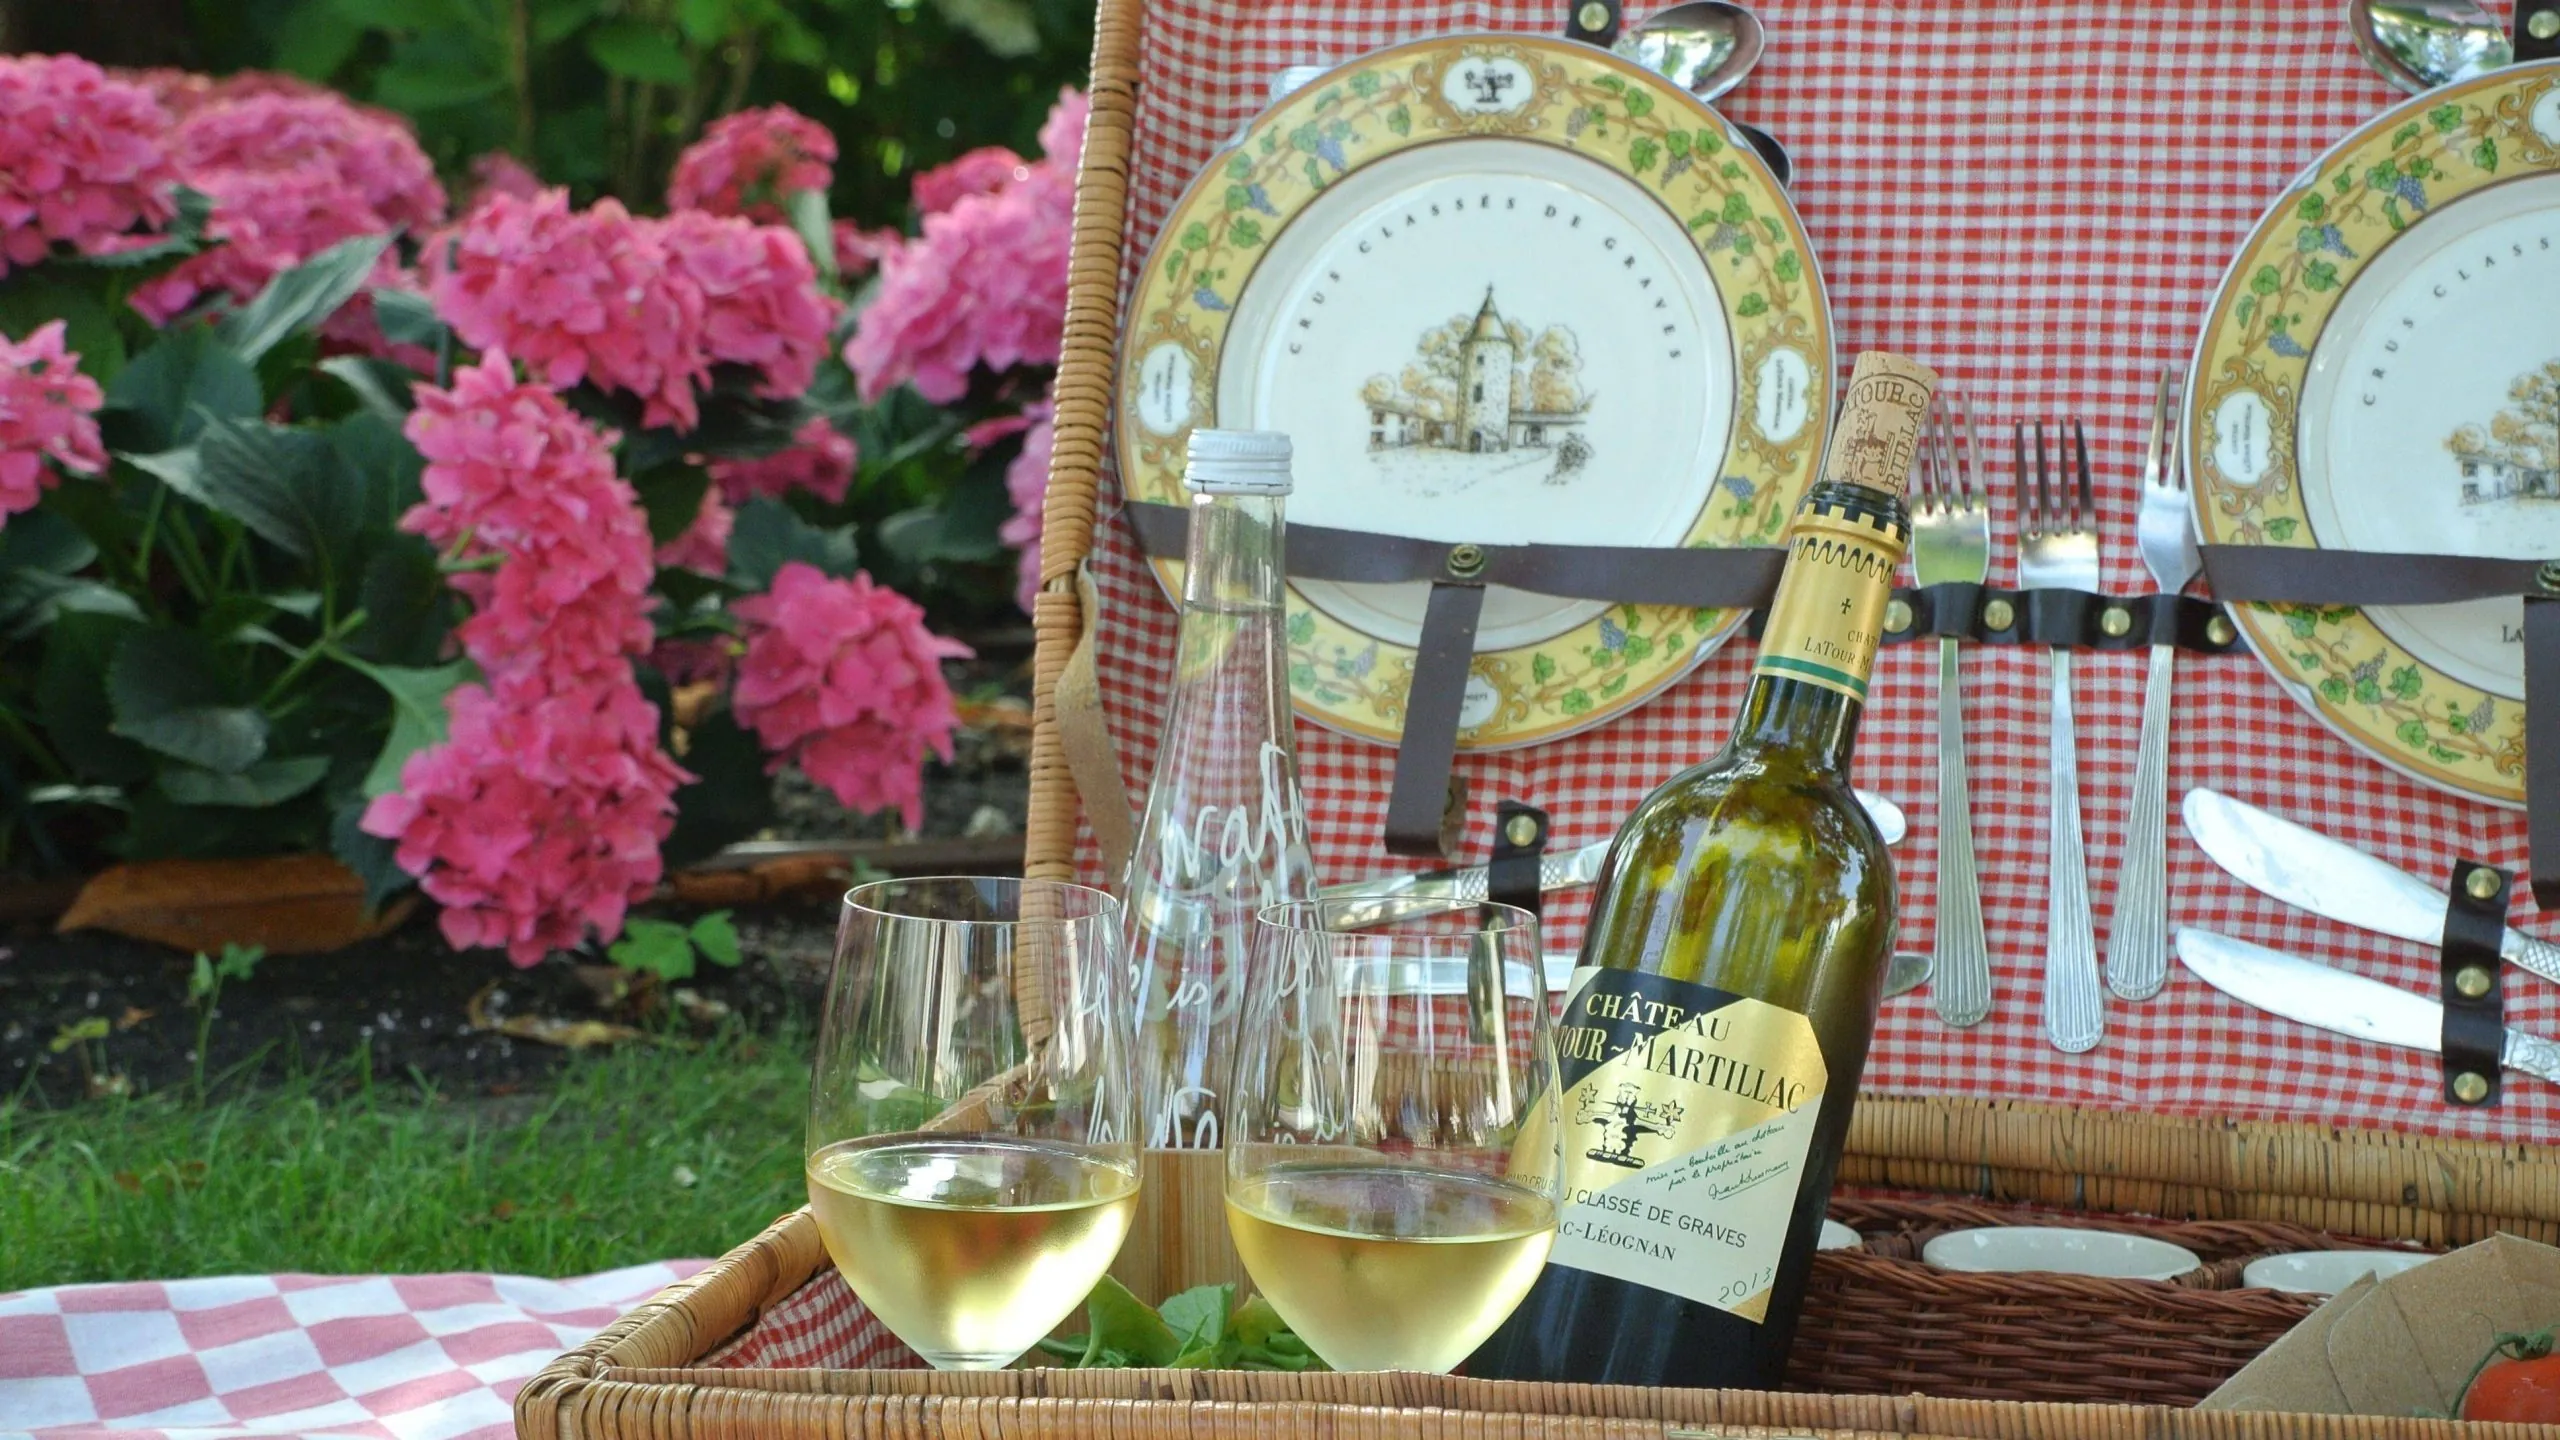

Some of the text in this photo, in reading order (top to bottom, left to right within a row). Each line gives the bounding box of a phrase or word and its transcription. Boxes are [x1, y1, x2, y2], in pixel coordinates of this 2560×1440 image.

[1289, 193, 1682, 359] CRUS CLASSÉS DE GRAVES
[2363, 236, 2550, 406] CRUS CLASS
[1847, 380, 1905, 412] TOUR
[1880, 392, 1925, 490] RTILLAC
[1847, 630, 1878, 649] CHAT
[2502, 623, 2524, 643] LA
[1586, 991, 1732, 1042] CHÂTEAU
[1576, 1189, 1642, 1217] CLASSÉ
[1647, 1205, 1674, 1226] DE
[1678, 1214, 1747, 1249] GRAVES
[1718, 1266, 1772, 1304] 2013
